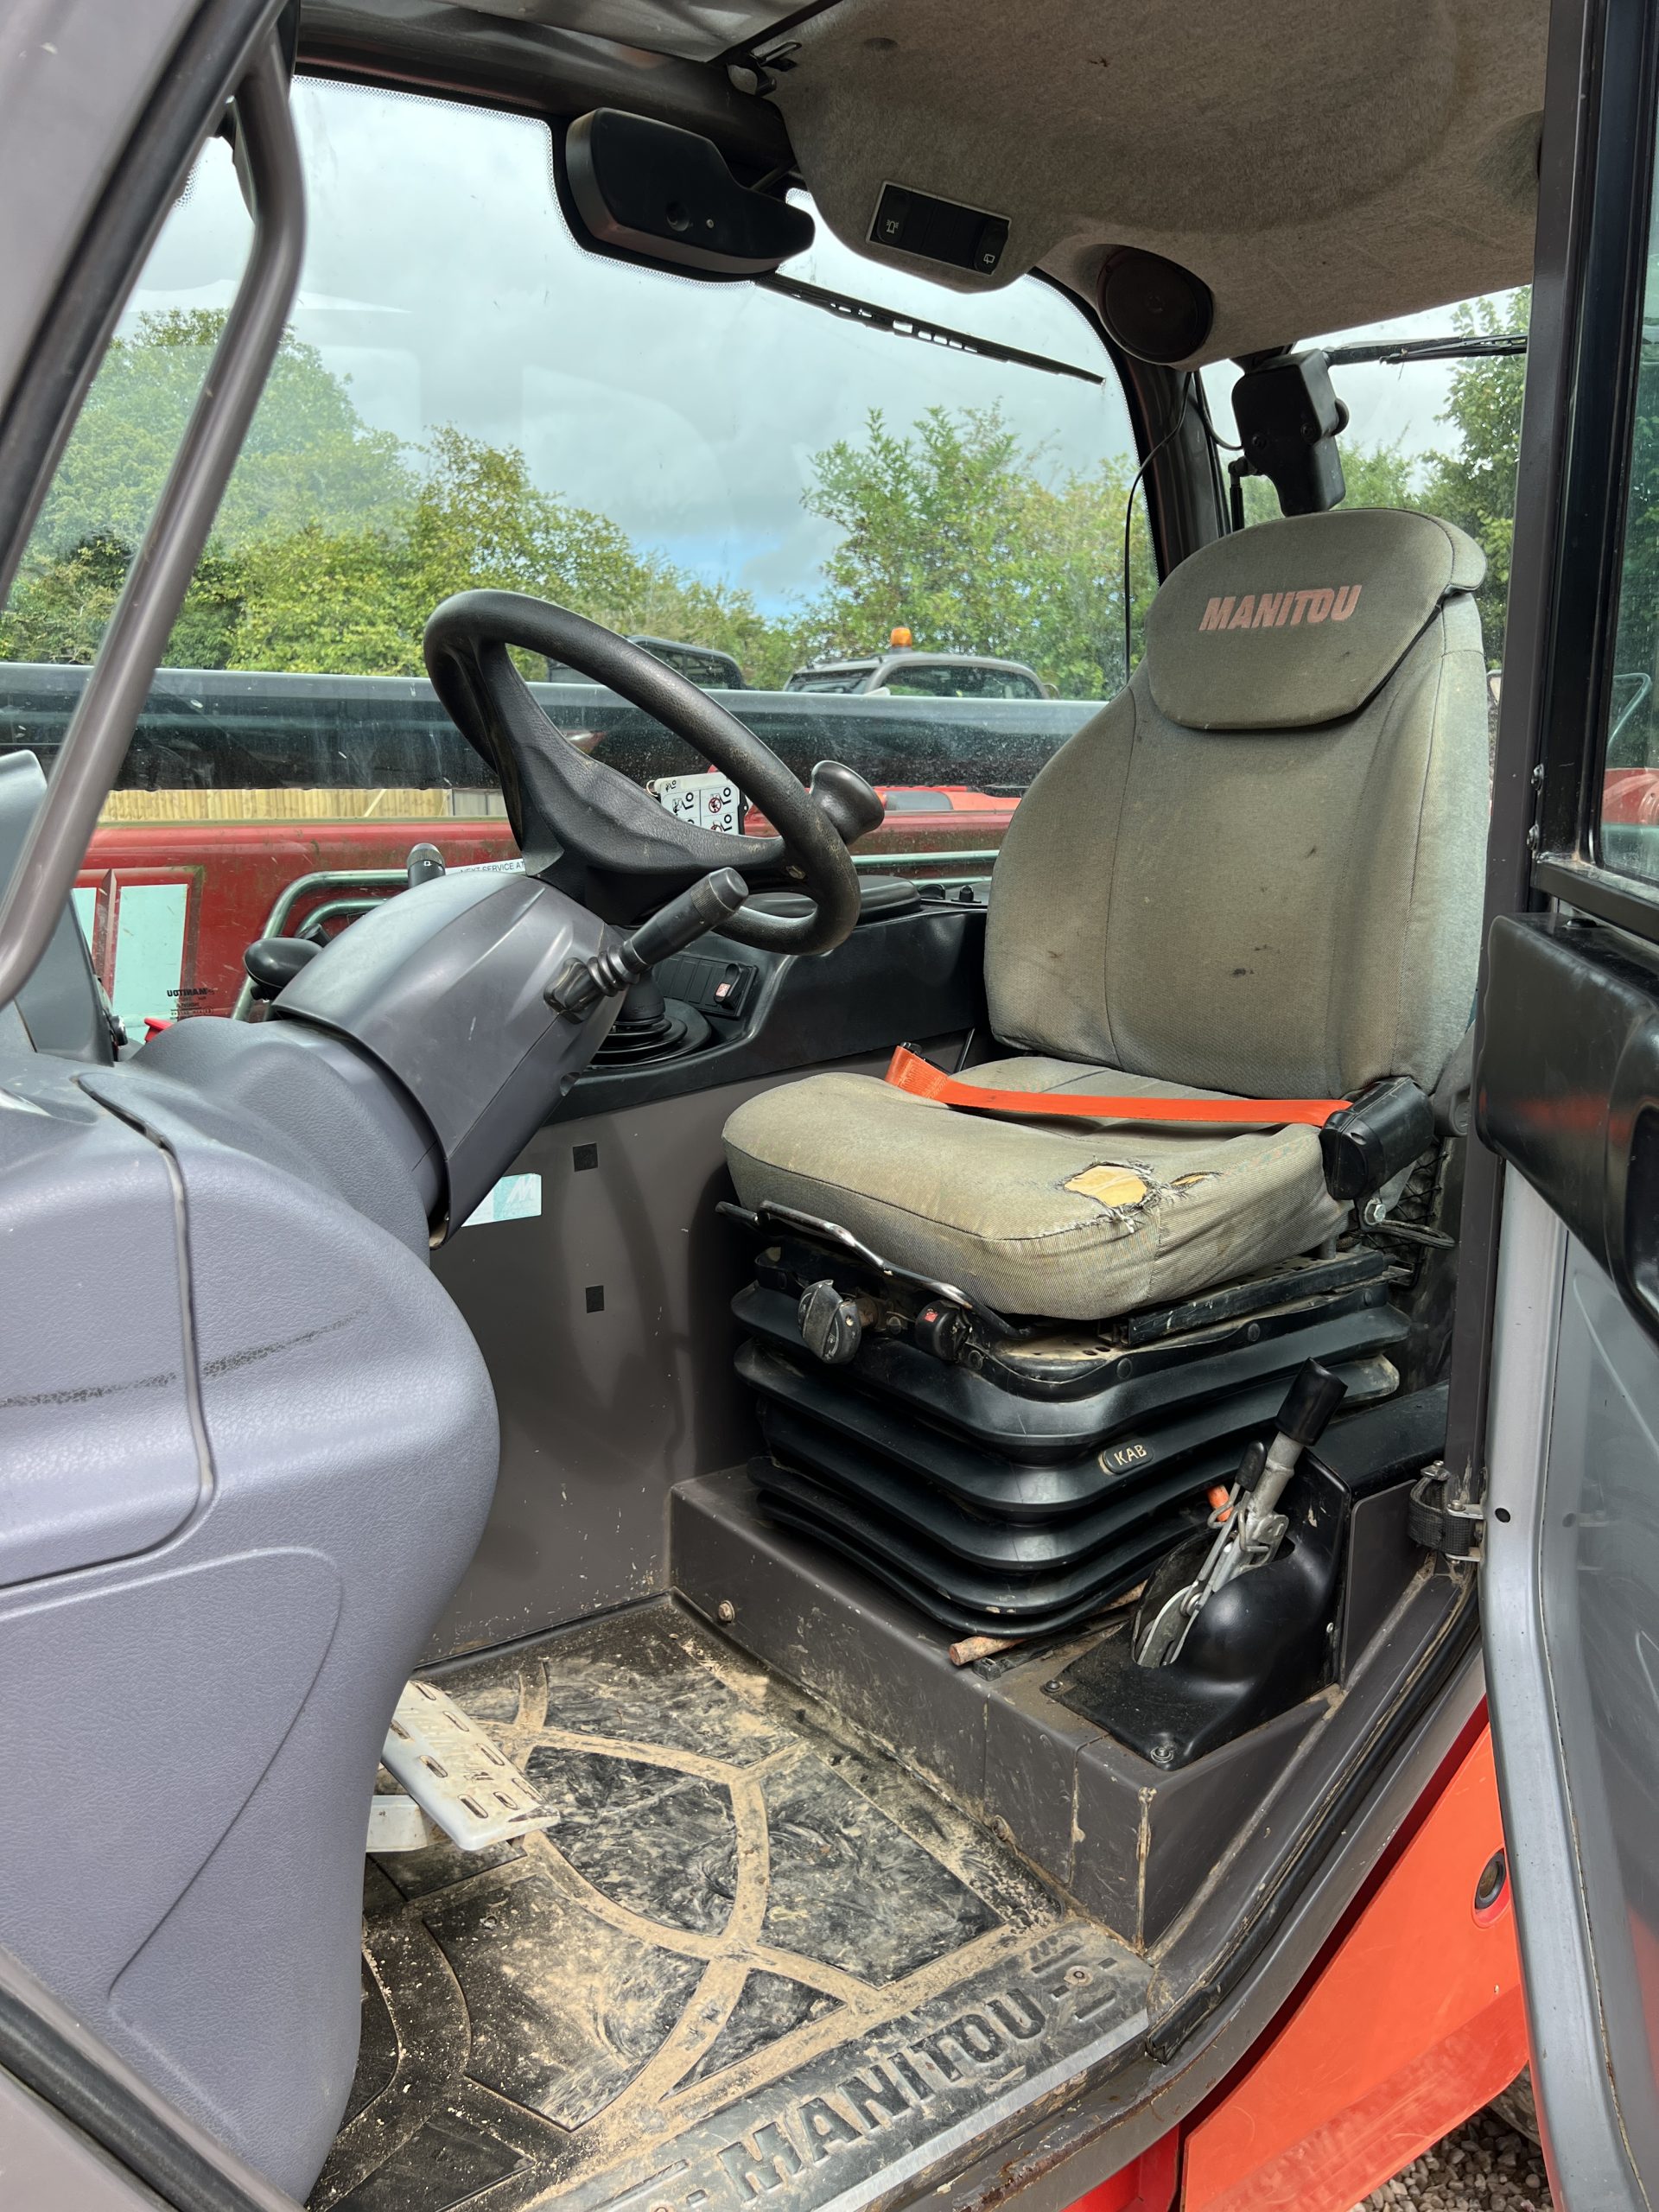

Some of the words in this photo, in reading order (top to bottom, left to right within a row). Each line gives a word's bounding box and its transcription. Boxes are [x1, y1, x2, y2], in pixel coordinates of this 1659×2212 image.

[1199, 585, 1362, 631] MANITOU
[483, 862, 515, 873] SERVICE
[1114, 1444, 1147, 1465] KAB
[718, 1987, 1046, 2202] MANITOU
